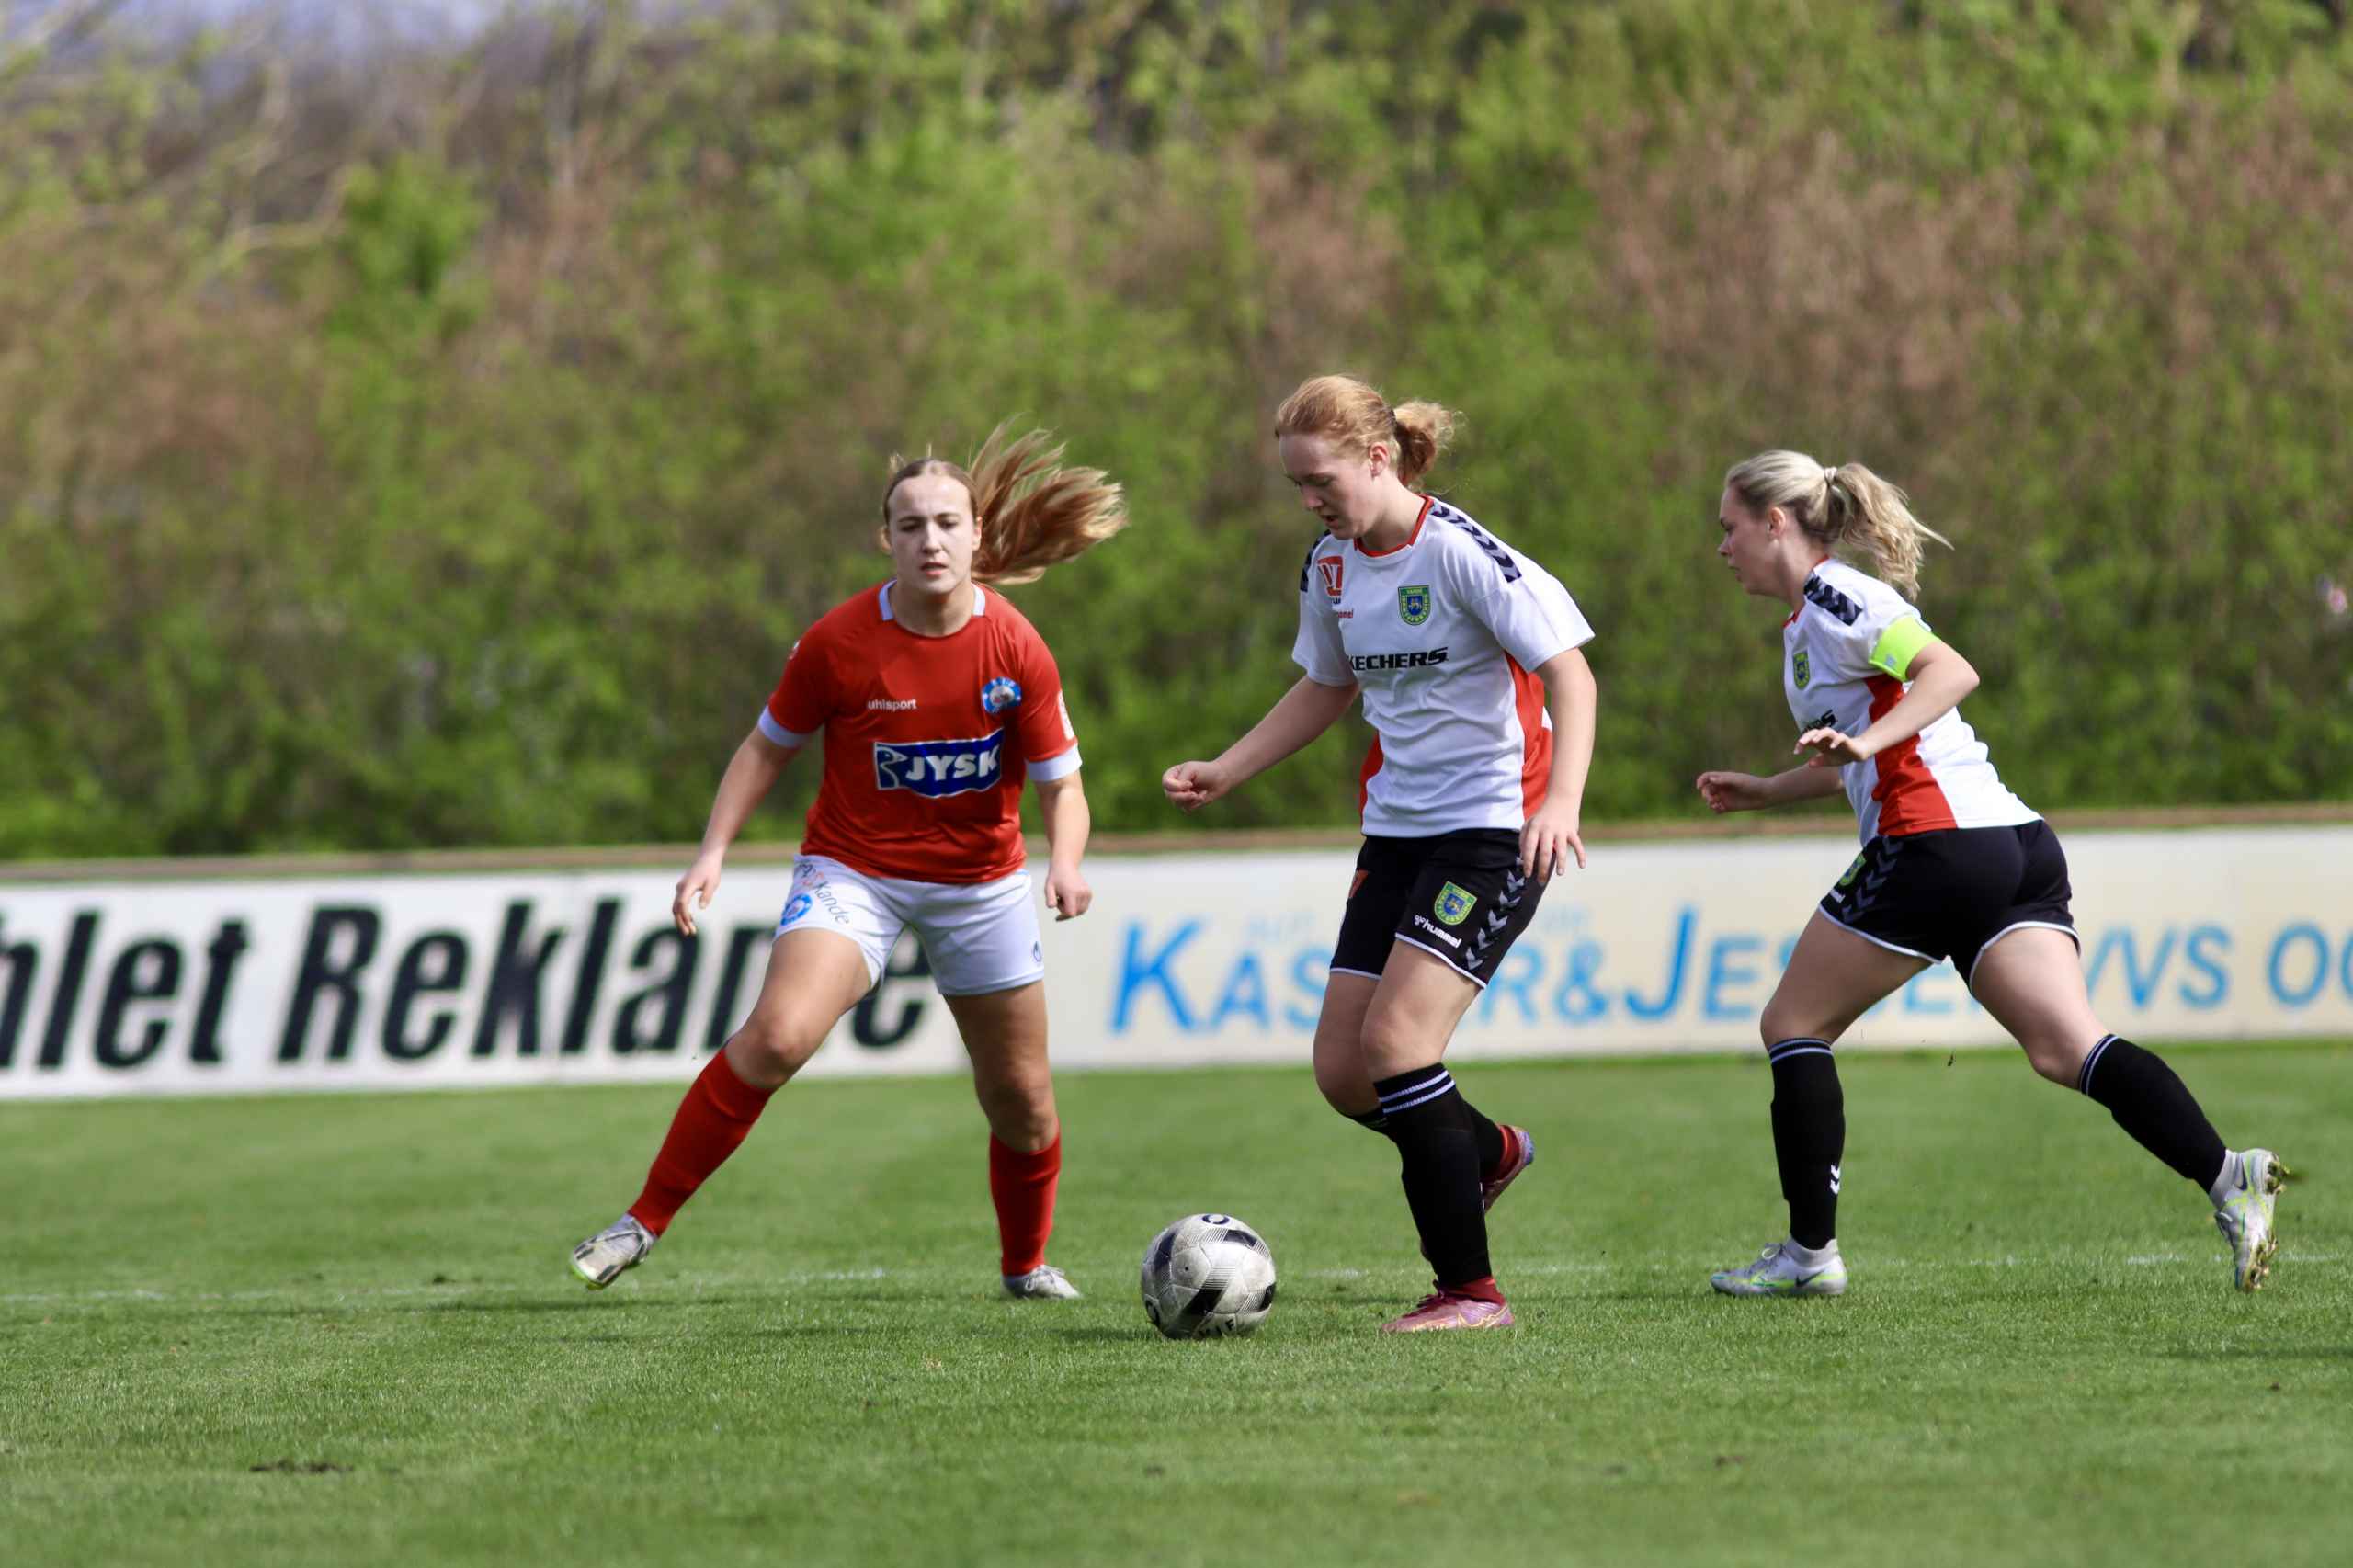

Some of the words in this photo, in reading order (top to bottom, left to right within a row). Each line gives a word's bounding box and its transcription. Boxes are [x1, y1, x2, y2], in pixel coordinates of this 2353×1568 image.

[867, 698, 917, 712] uhlsport
[904, 744, 1000, 781] JYSK
[1421, 917, 1462, 949] hummel
[276, 893, 932, 1066] Reklae
[2266, 919, 2353, 1011] O
